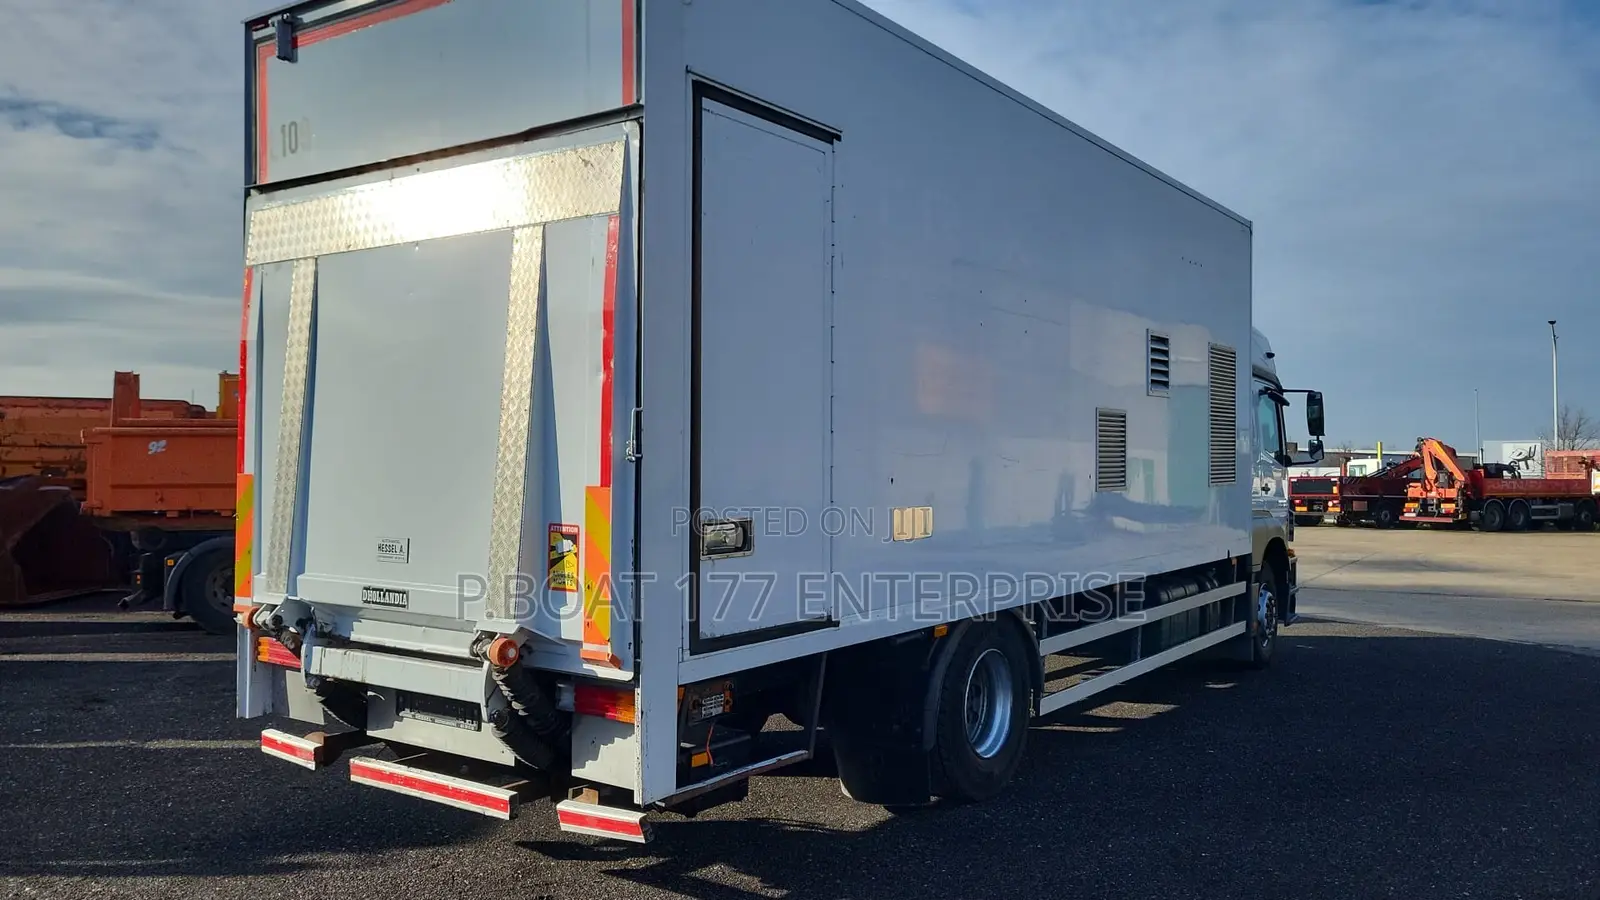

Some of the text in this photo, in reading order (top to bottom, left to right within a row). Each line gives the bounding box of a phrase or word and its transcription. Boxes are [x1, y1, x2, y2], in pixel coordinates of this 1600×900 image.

[549, 525, 579, 533] ATTENTION
[377, 543, 397, 553] HESSEL
[362, 589, 407, 605] DHOLLANDIA
